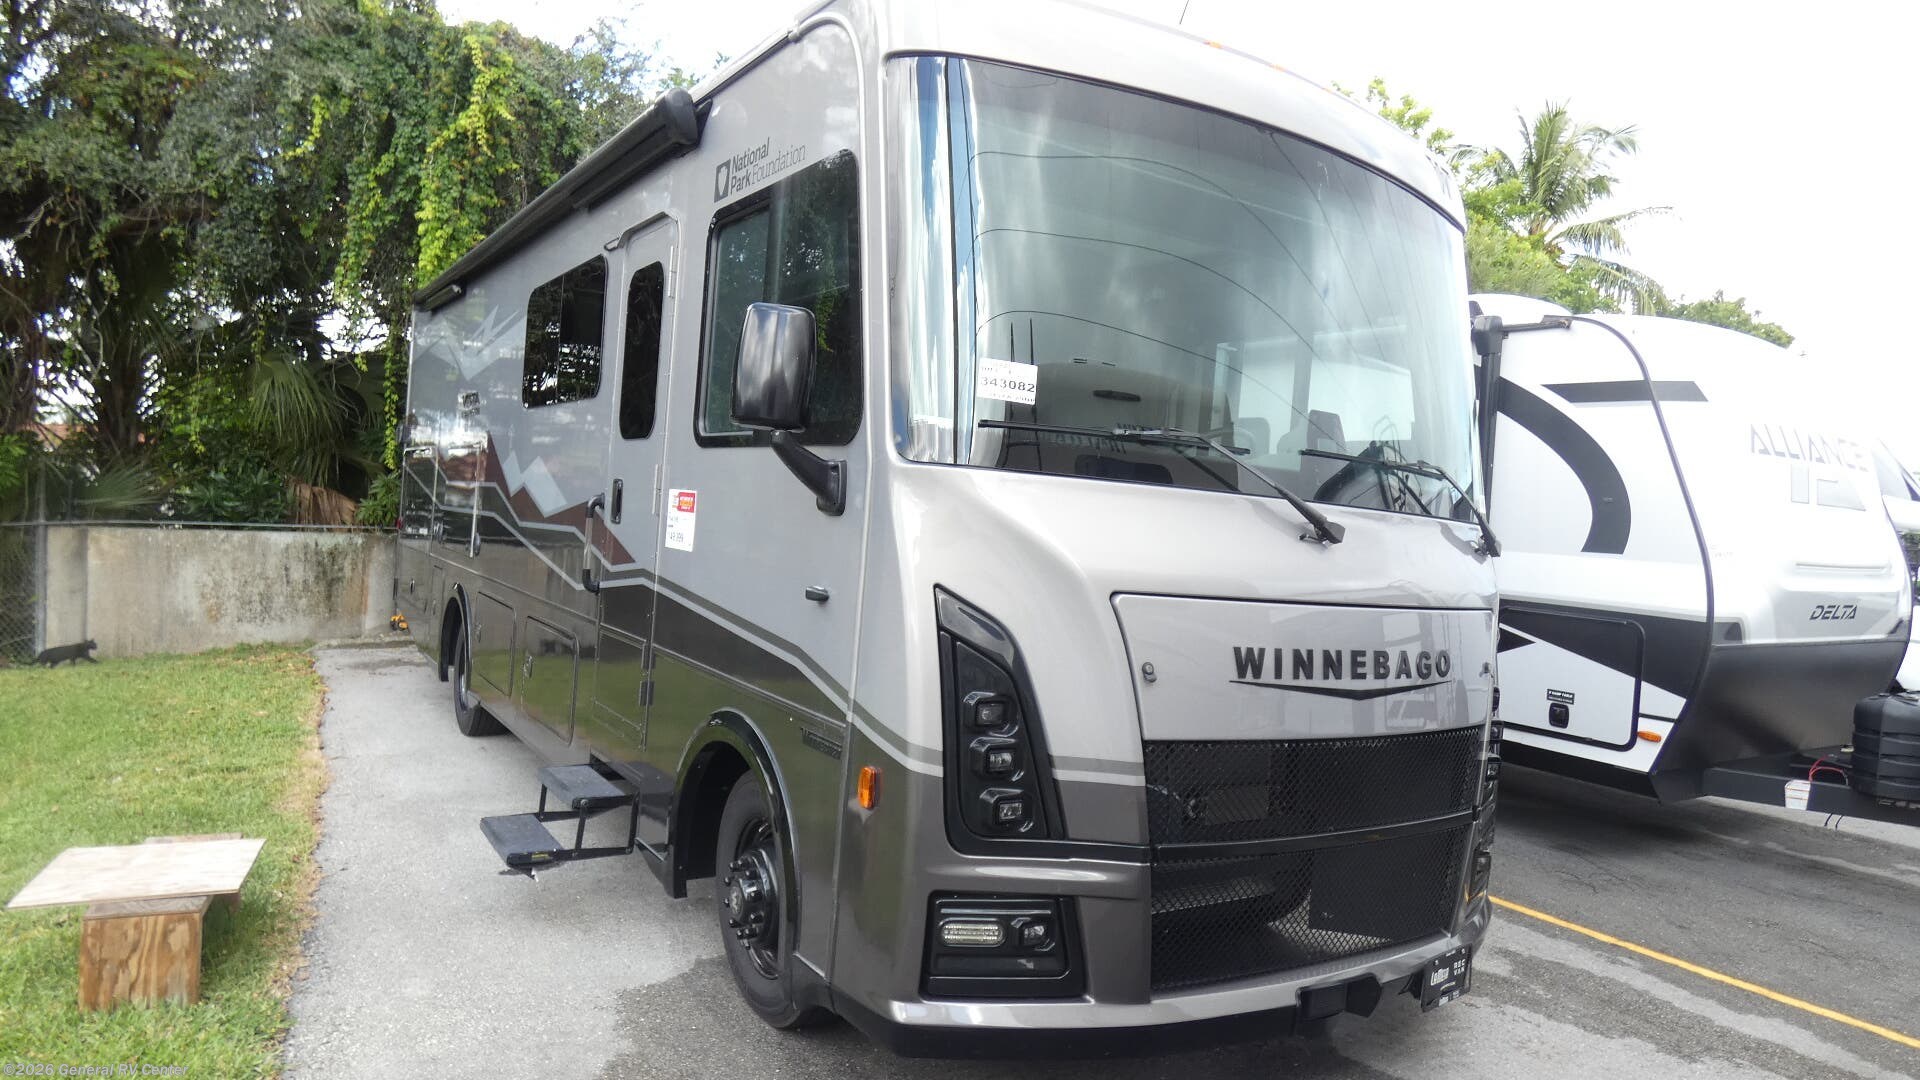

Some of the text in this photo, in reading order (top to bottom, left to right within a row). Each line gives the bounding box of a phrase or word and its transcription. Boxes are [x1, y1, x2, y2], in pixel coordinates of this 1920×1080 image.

[730, 144, 806, 195] Park Foundation
[732, 137, 770, 173] National
[981, 376, 1035, 393] 343082
[1750, 423, 1869, 473] ALLIANCE
[1809, 605, 1858, 621] DELTA
[1232, 646, 1451, 680] WINNEBAGO
